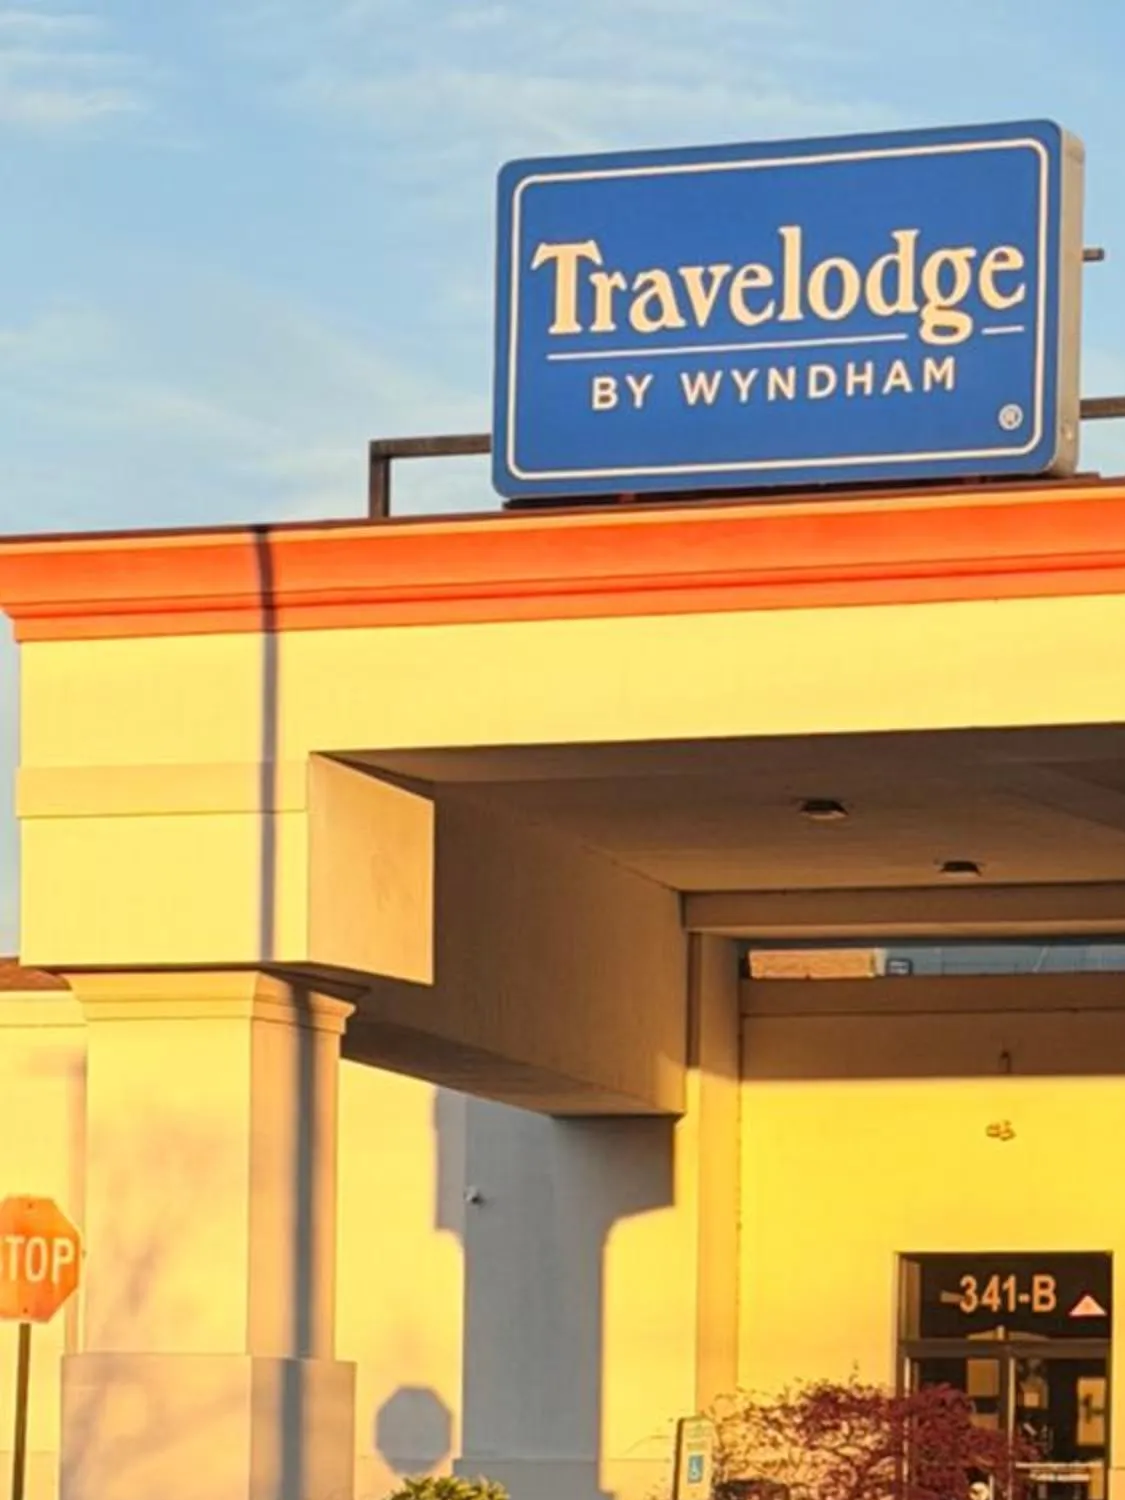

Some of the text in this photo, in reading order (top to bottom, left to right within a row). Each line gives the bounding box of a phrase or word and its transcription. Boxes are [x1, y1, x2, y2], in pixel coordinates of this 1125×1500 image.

[531, 226, 1025, 345] Travelodge
[592, 357, 956, 411] BY WYNDHAM
[0, 1235, 76, 1285] TOP
[959, 1274, 1056, 1313] 341-B
